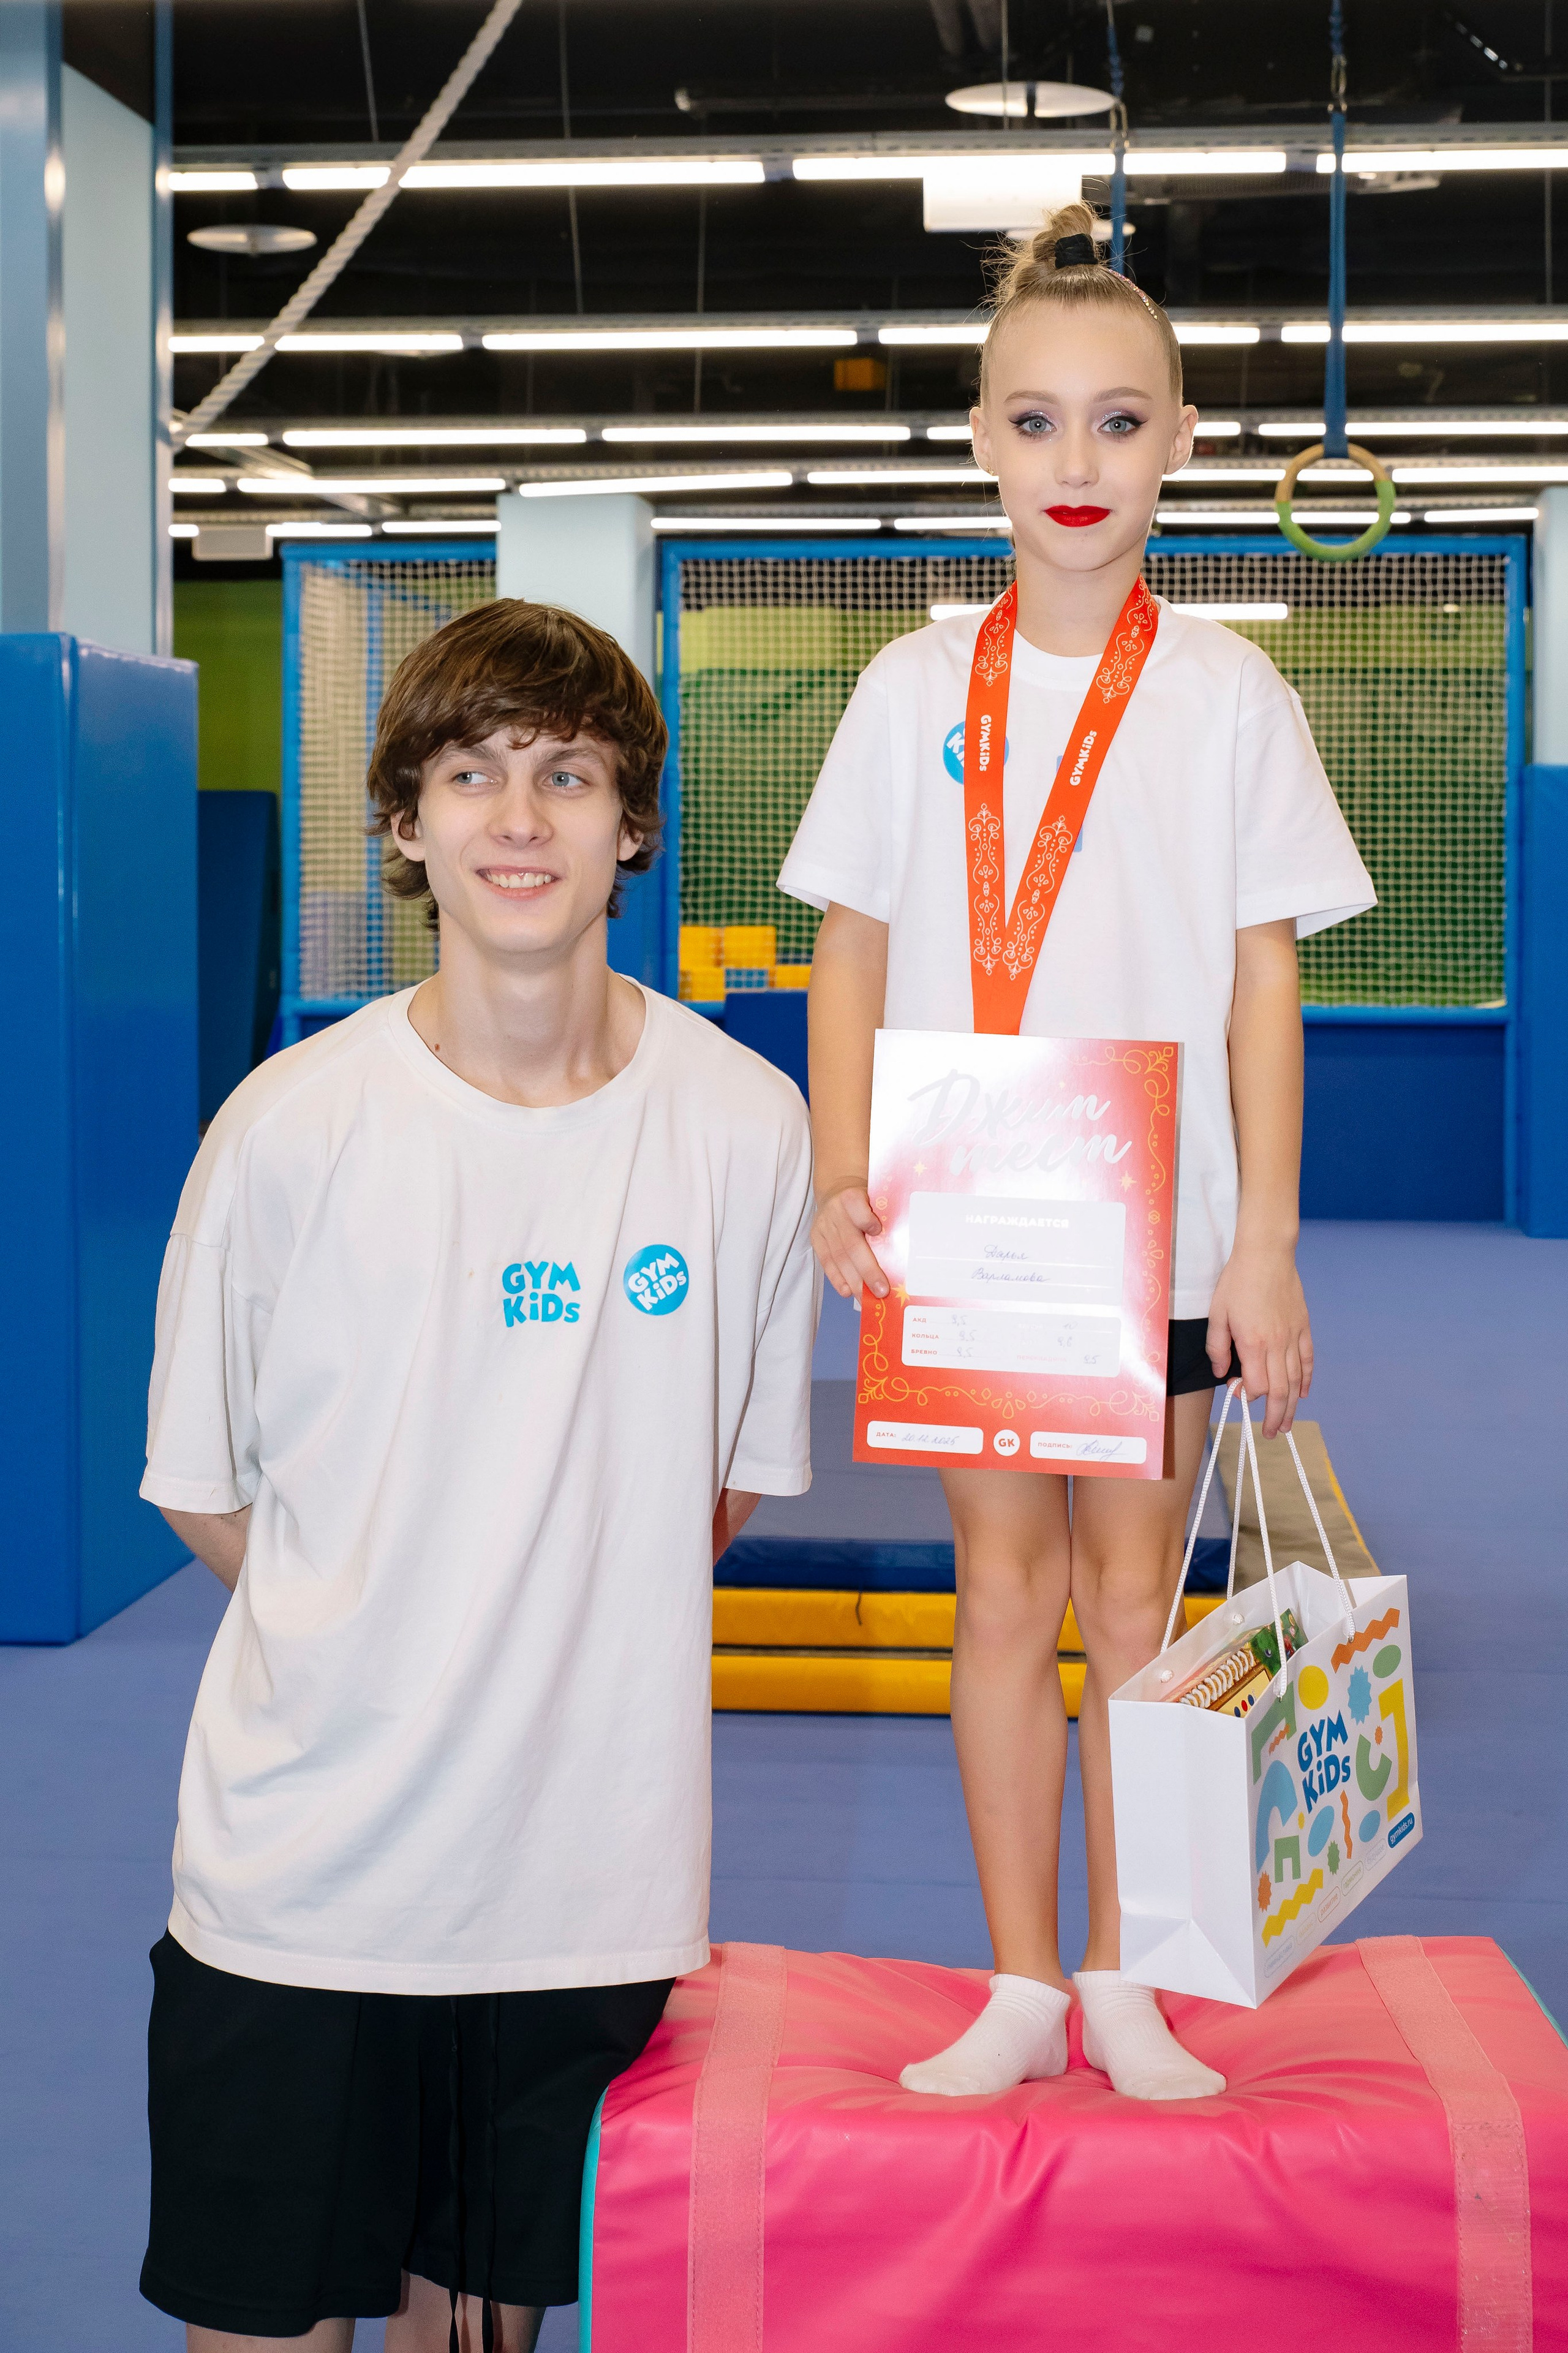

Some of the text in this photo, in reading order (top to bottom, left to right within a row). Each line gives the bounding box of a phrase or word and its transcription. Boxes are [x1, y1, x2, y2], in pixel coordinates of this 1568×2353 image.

[950, 1133, 1132, 1176] тест
[966, 1215, 1069, 1229] НАГРАЖДАЕТСЯ
[502, 1261, 581, 1294] GYM
[628, 1252, 680, 1293] GYM
[998, 1438, 1015, 1448] GK
[1298, 1710, 1349, 1772] GYM
[1390, 1818, 1412, 1845] gymkids.ru
